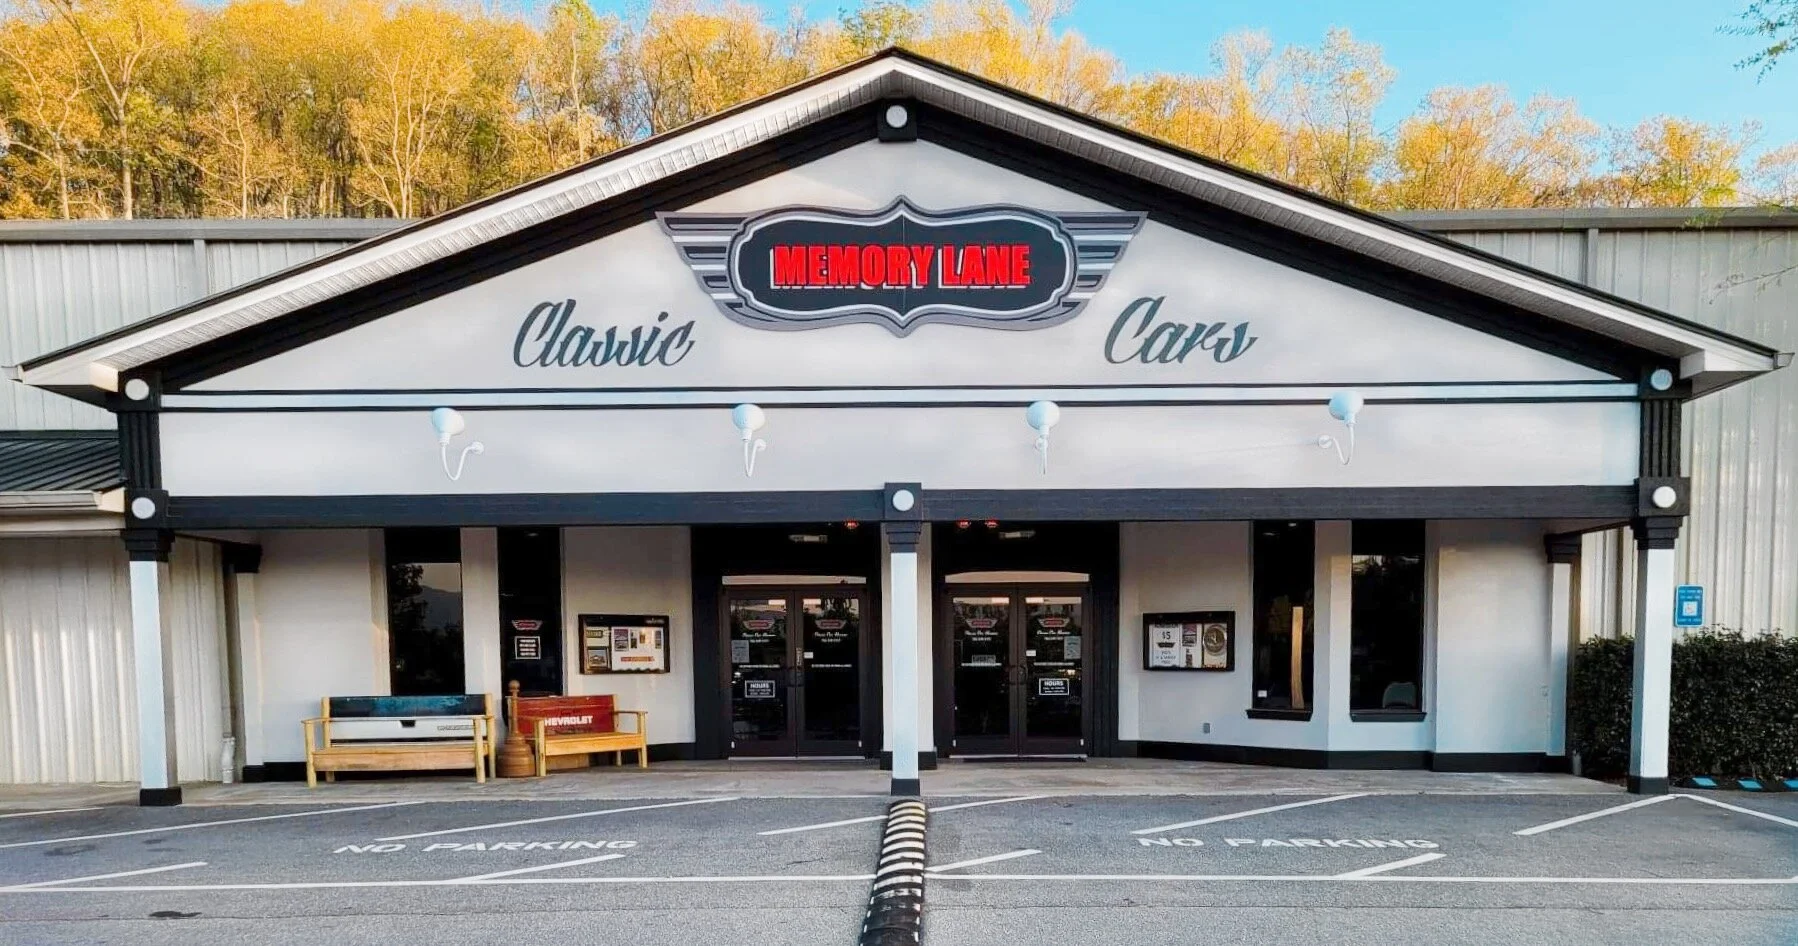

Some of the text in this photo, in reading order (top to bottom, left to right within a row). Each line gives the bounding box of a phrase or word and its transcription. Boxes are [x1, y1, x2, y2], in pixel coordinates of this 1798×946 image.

[770, 243, 1034, 289] MEMORY LANE
[513, 298, 696, 369] Classic
[1104, 296, 1257, 365] Cars
[544, 715, 593, 726] HEVROLET
[332, 839, 640, 854] NO PARKING
[1137, 837, 1440, 849] NO PARKING
